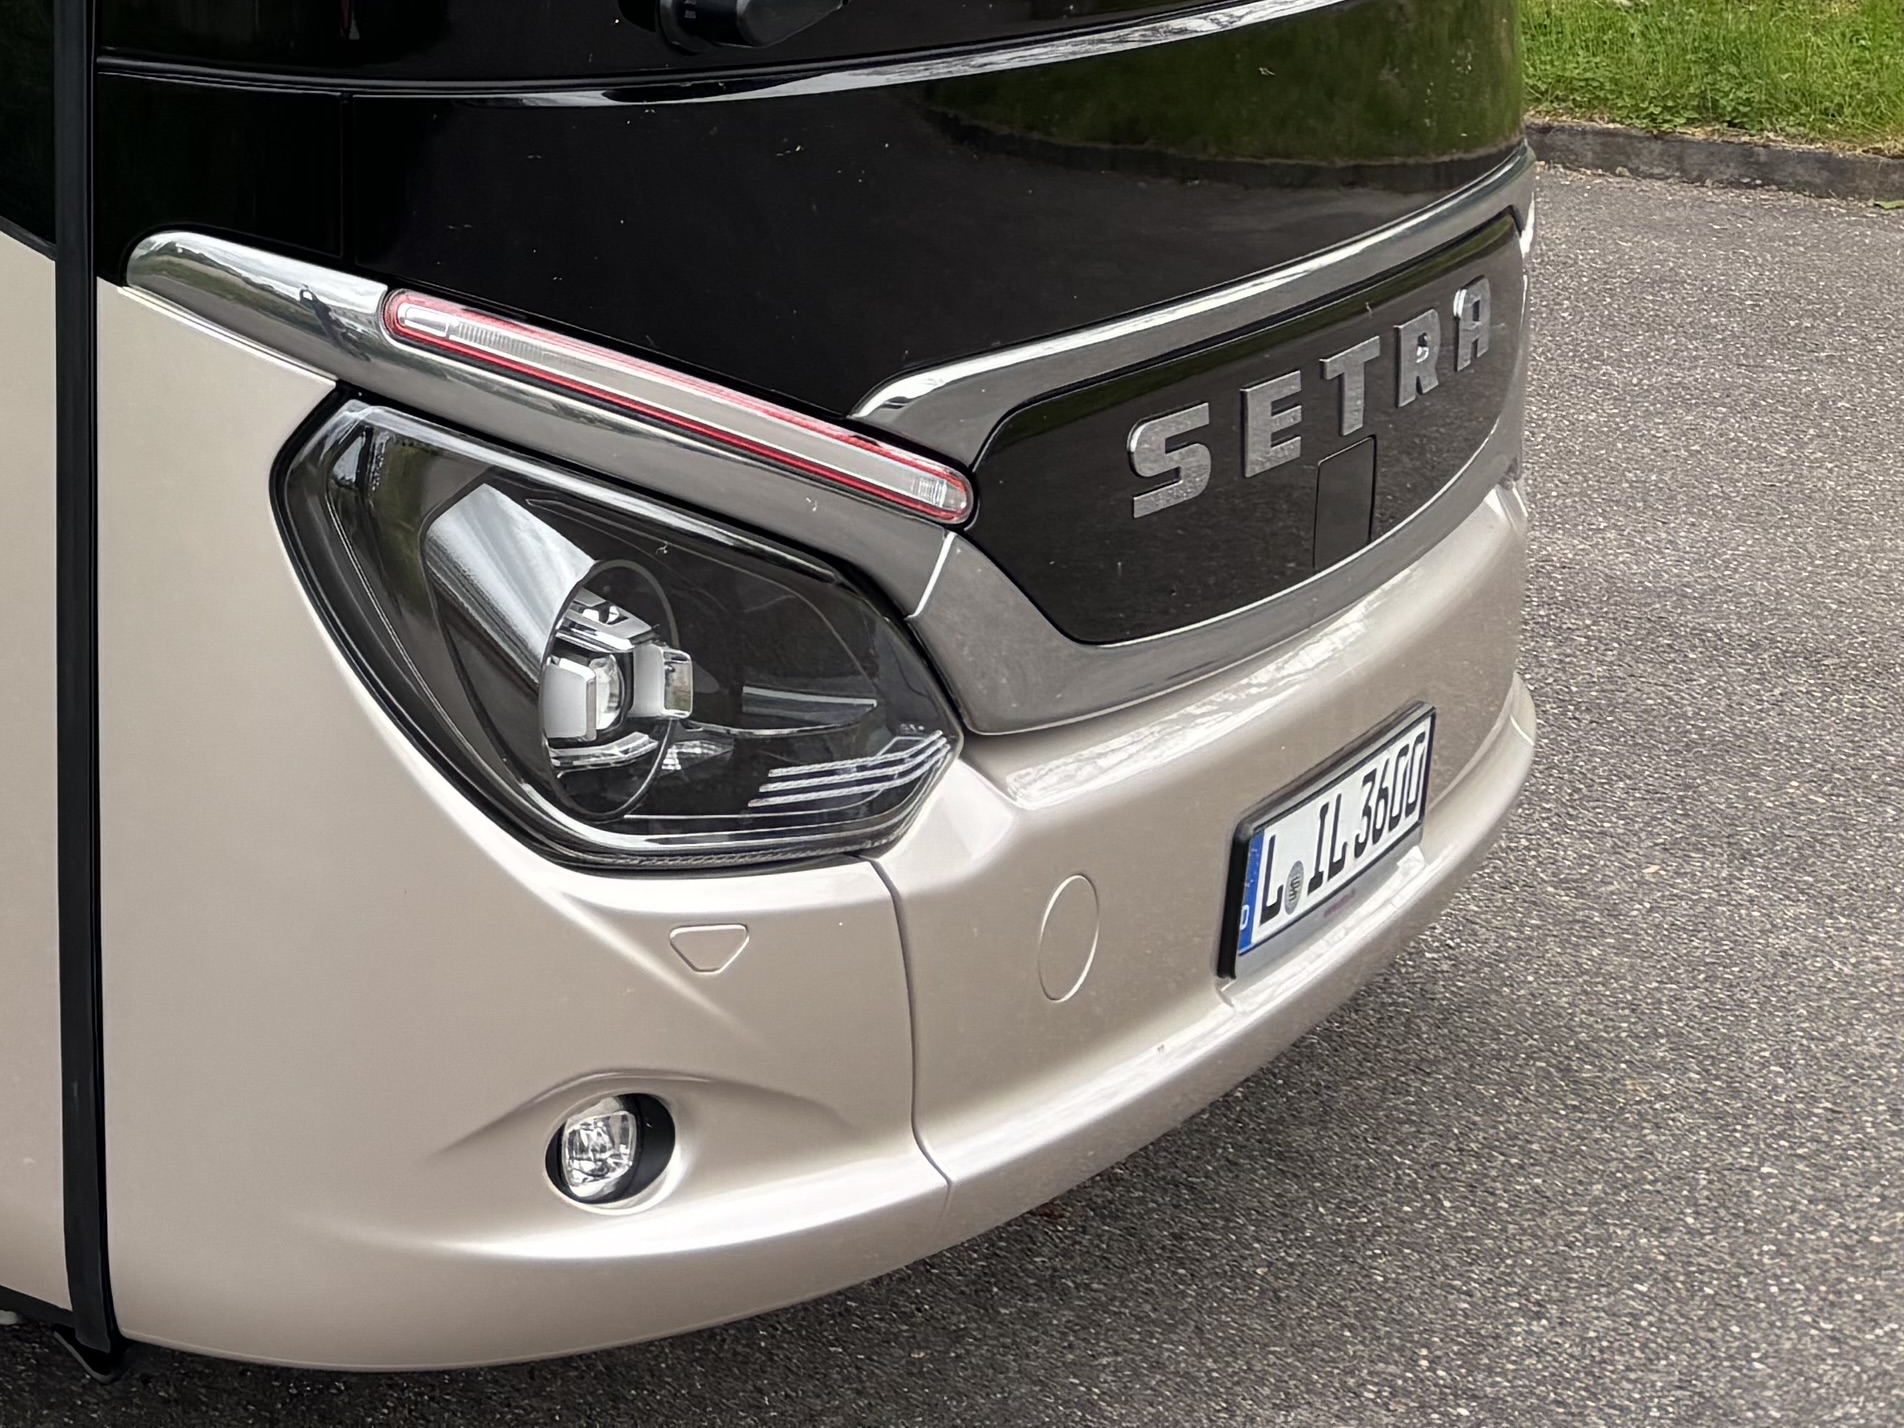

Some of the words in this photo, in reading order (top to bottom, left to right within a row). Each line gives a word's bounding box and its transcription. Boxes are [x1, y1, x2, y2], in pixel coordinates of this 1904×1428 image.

[1127, 275, 1491, 519] SETRA
[1260, 834, 1284, 926] L
[1307, 793, 1347, 896] IL
[1354, 730, 1426, 859] 3600
